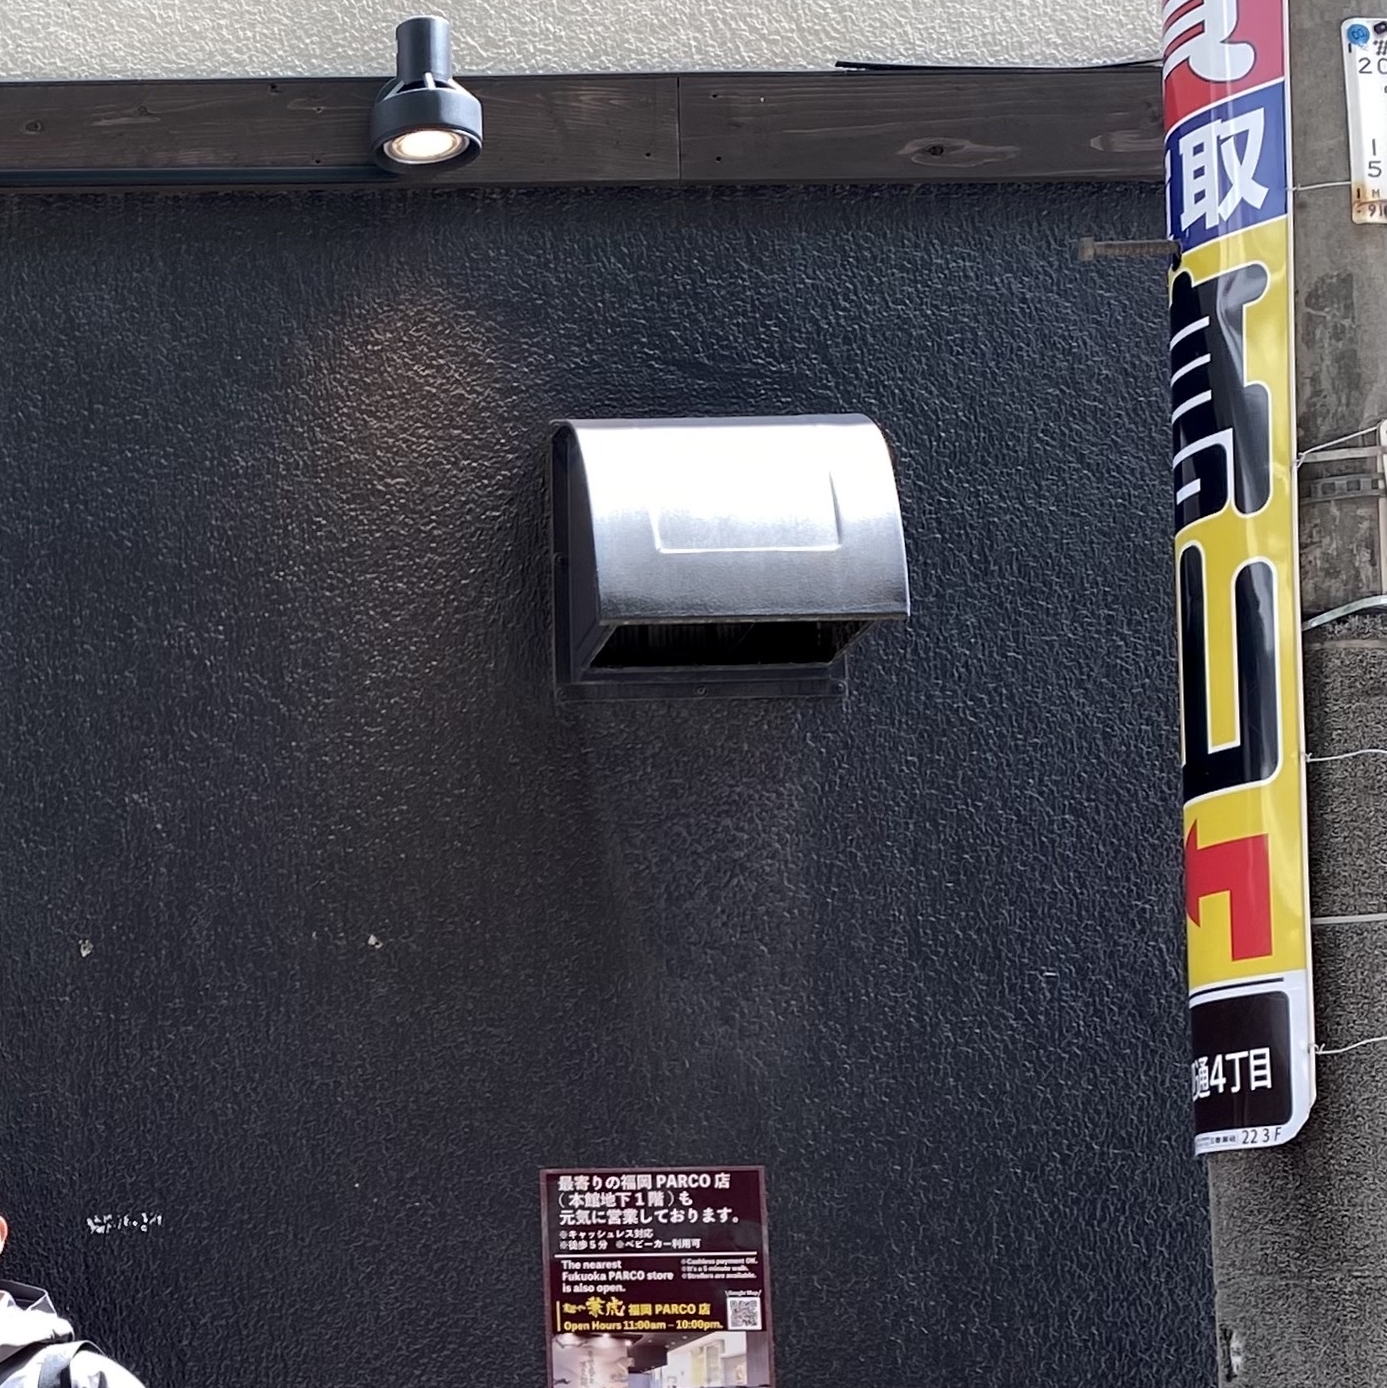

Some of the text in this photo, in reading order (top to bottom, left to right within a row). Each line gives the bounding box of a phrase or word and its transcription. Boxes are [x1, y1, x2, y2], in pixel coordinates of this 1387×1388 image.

[1166, 107, 1269, 241] 取
[558, 1173, 731, 1192] 最寄りの福岡 PARCO 店
[559, 1208, 739, 1226] 元気に営業しております。
[561, 1260, 621, 1270] The nearest
[562, 1271, 674, 1282] Fukuoka PARCO store
[562, 1283, 626, 1295] is also open.
[655, 1303, 696, 1316] PARCO
[699, 1303, 711, 1316] 店
[563, 1321, 589, 1332] Open
[591, 1321, 621, 1331] Hours
[623, 1320, 666, 1330] 11:00am
[676, 1320, 724, 1332] 10:00pm.
